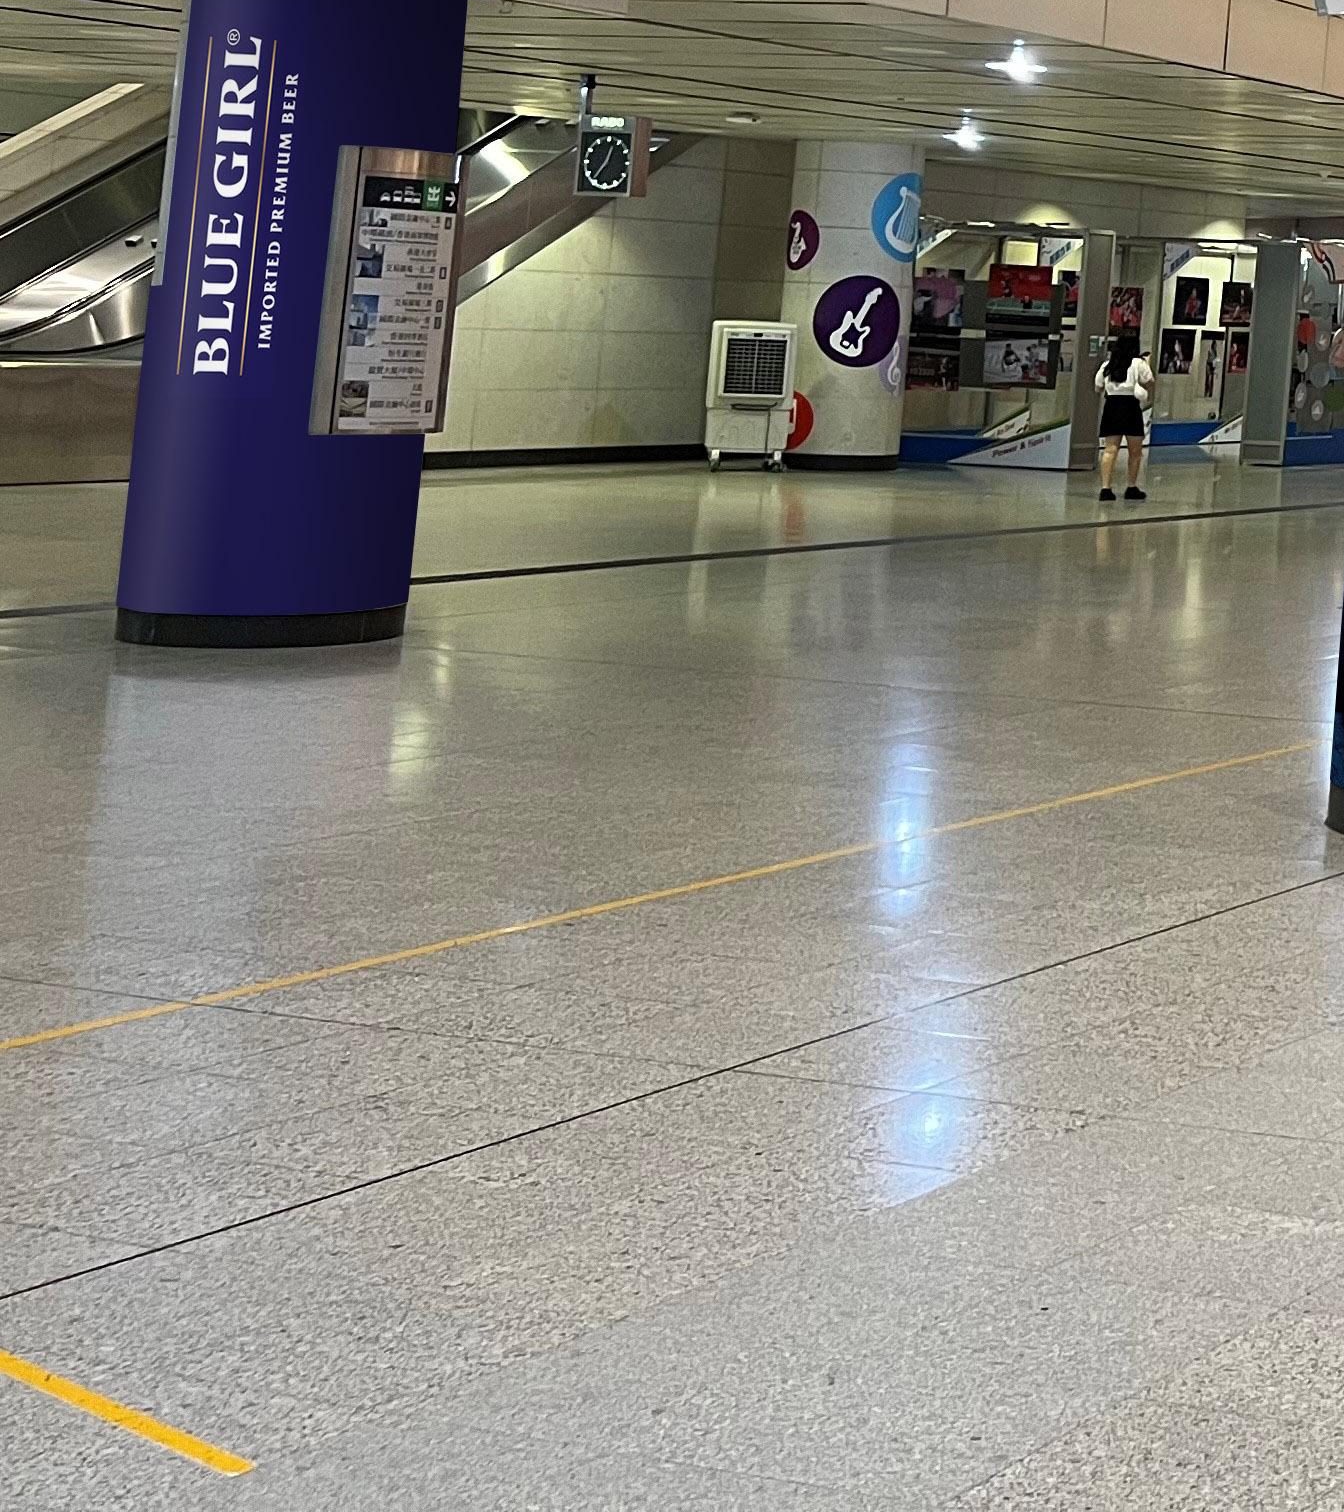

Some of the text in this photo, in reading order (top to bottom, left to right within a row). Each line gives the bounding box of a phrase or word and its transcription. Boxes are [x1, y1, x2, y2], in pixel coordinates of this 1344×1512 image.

[192, 212, 245, 376] BLUE
[257, 72, 300, 350] IMPORTED PREMIUM BEER
